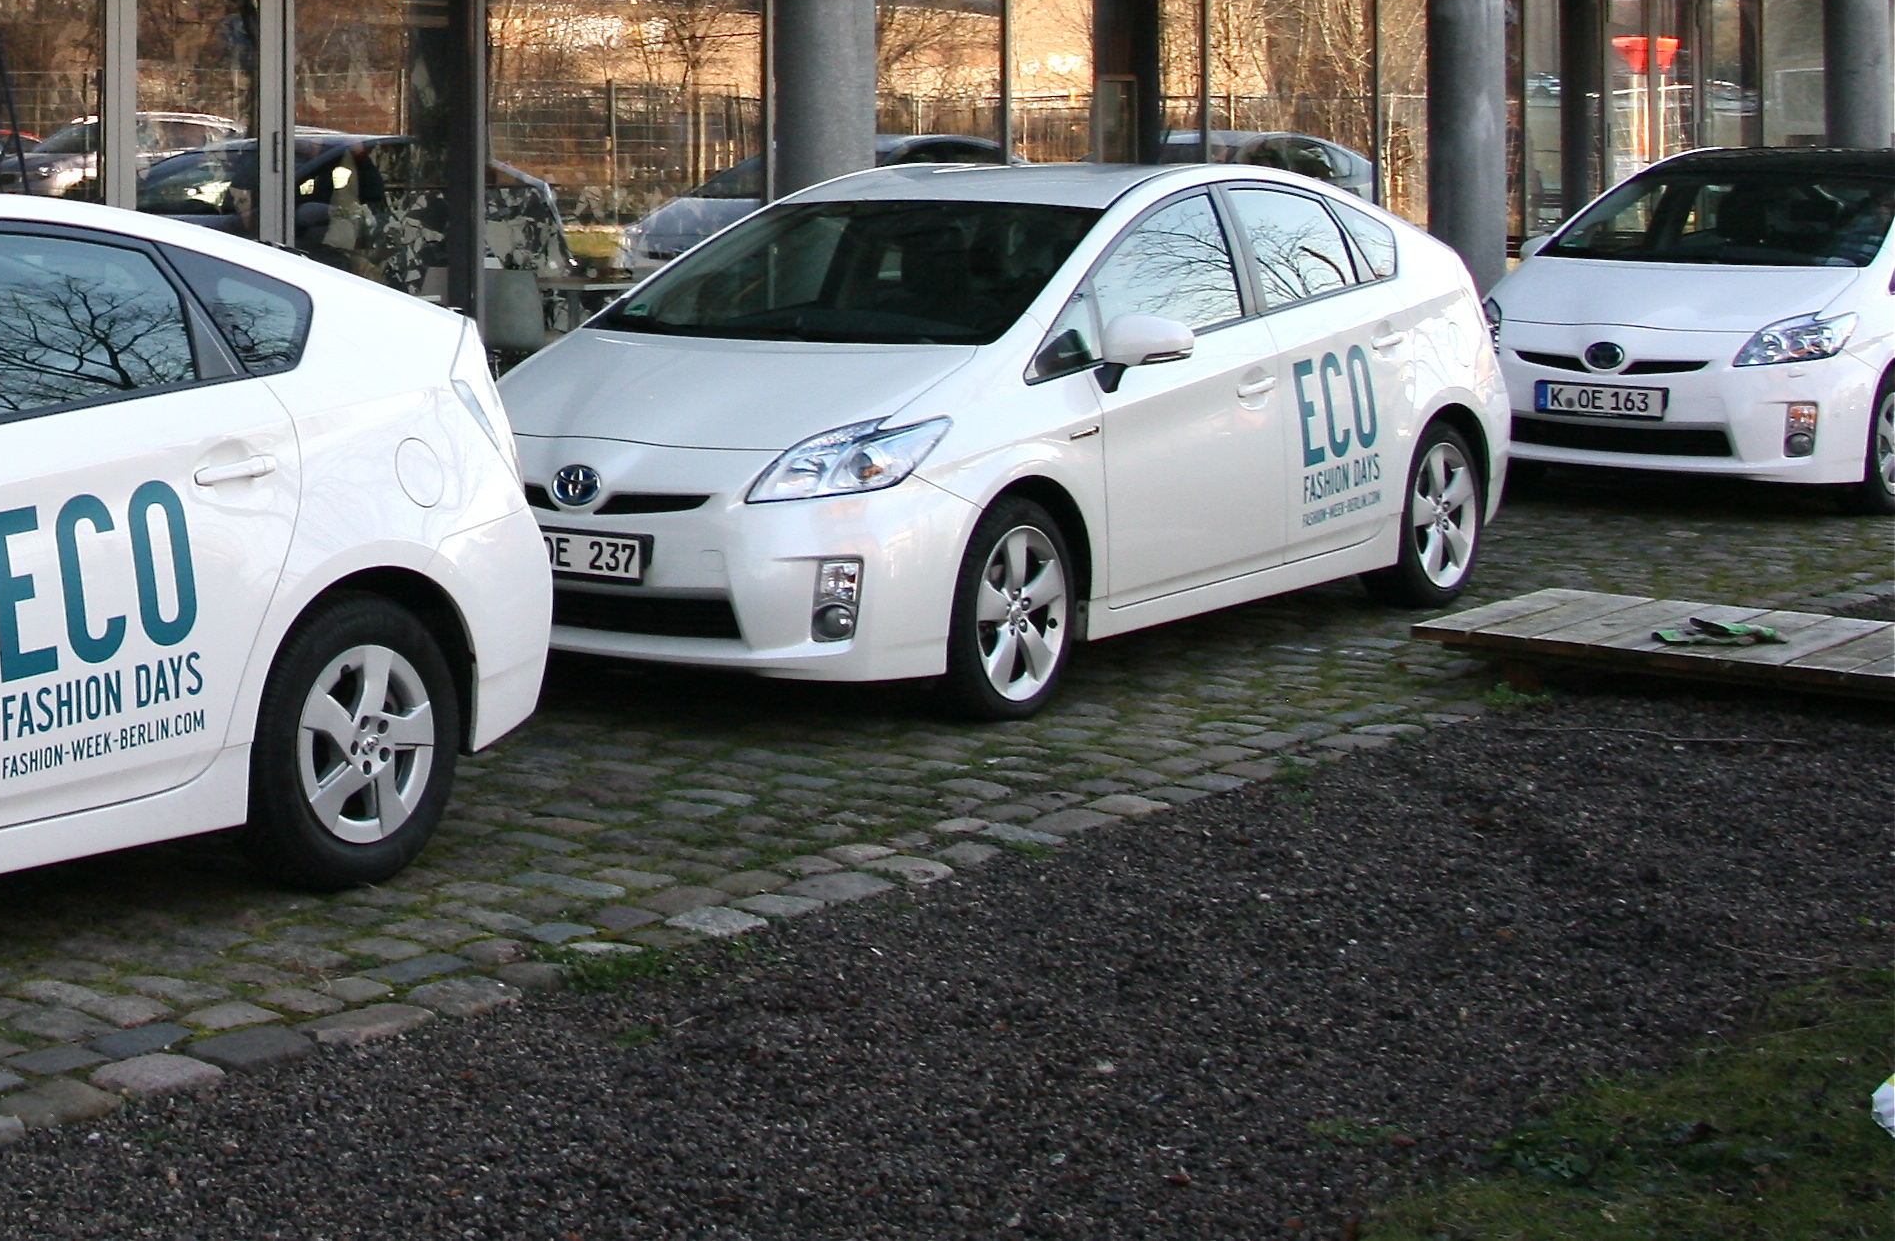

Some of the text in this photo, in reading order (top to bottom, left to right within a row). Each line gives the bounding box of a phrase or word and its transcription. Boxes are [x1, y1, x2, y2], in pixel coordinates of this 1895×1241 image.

[1292, 344, 1377, 468] ECO
[1550, 387, 1649, 412] K OE 163
[1304, 453, 1380, 505] FASHION DAYS
[589, 541, 636, 573] 237
[2, 651, 204, 741] FASHION DAYS
[2, 708, 205, 780] FASHION-WEEK-BERLIN.COM
